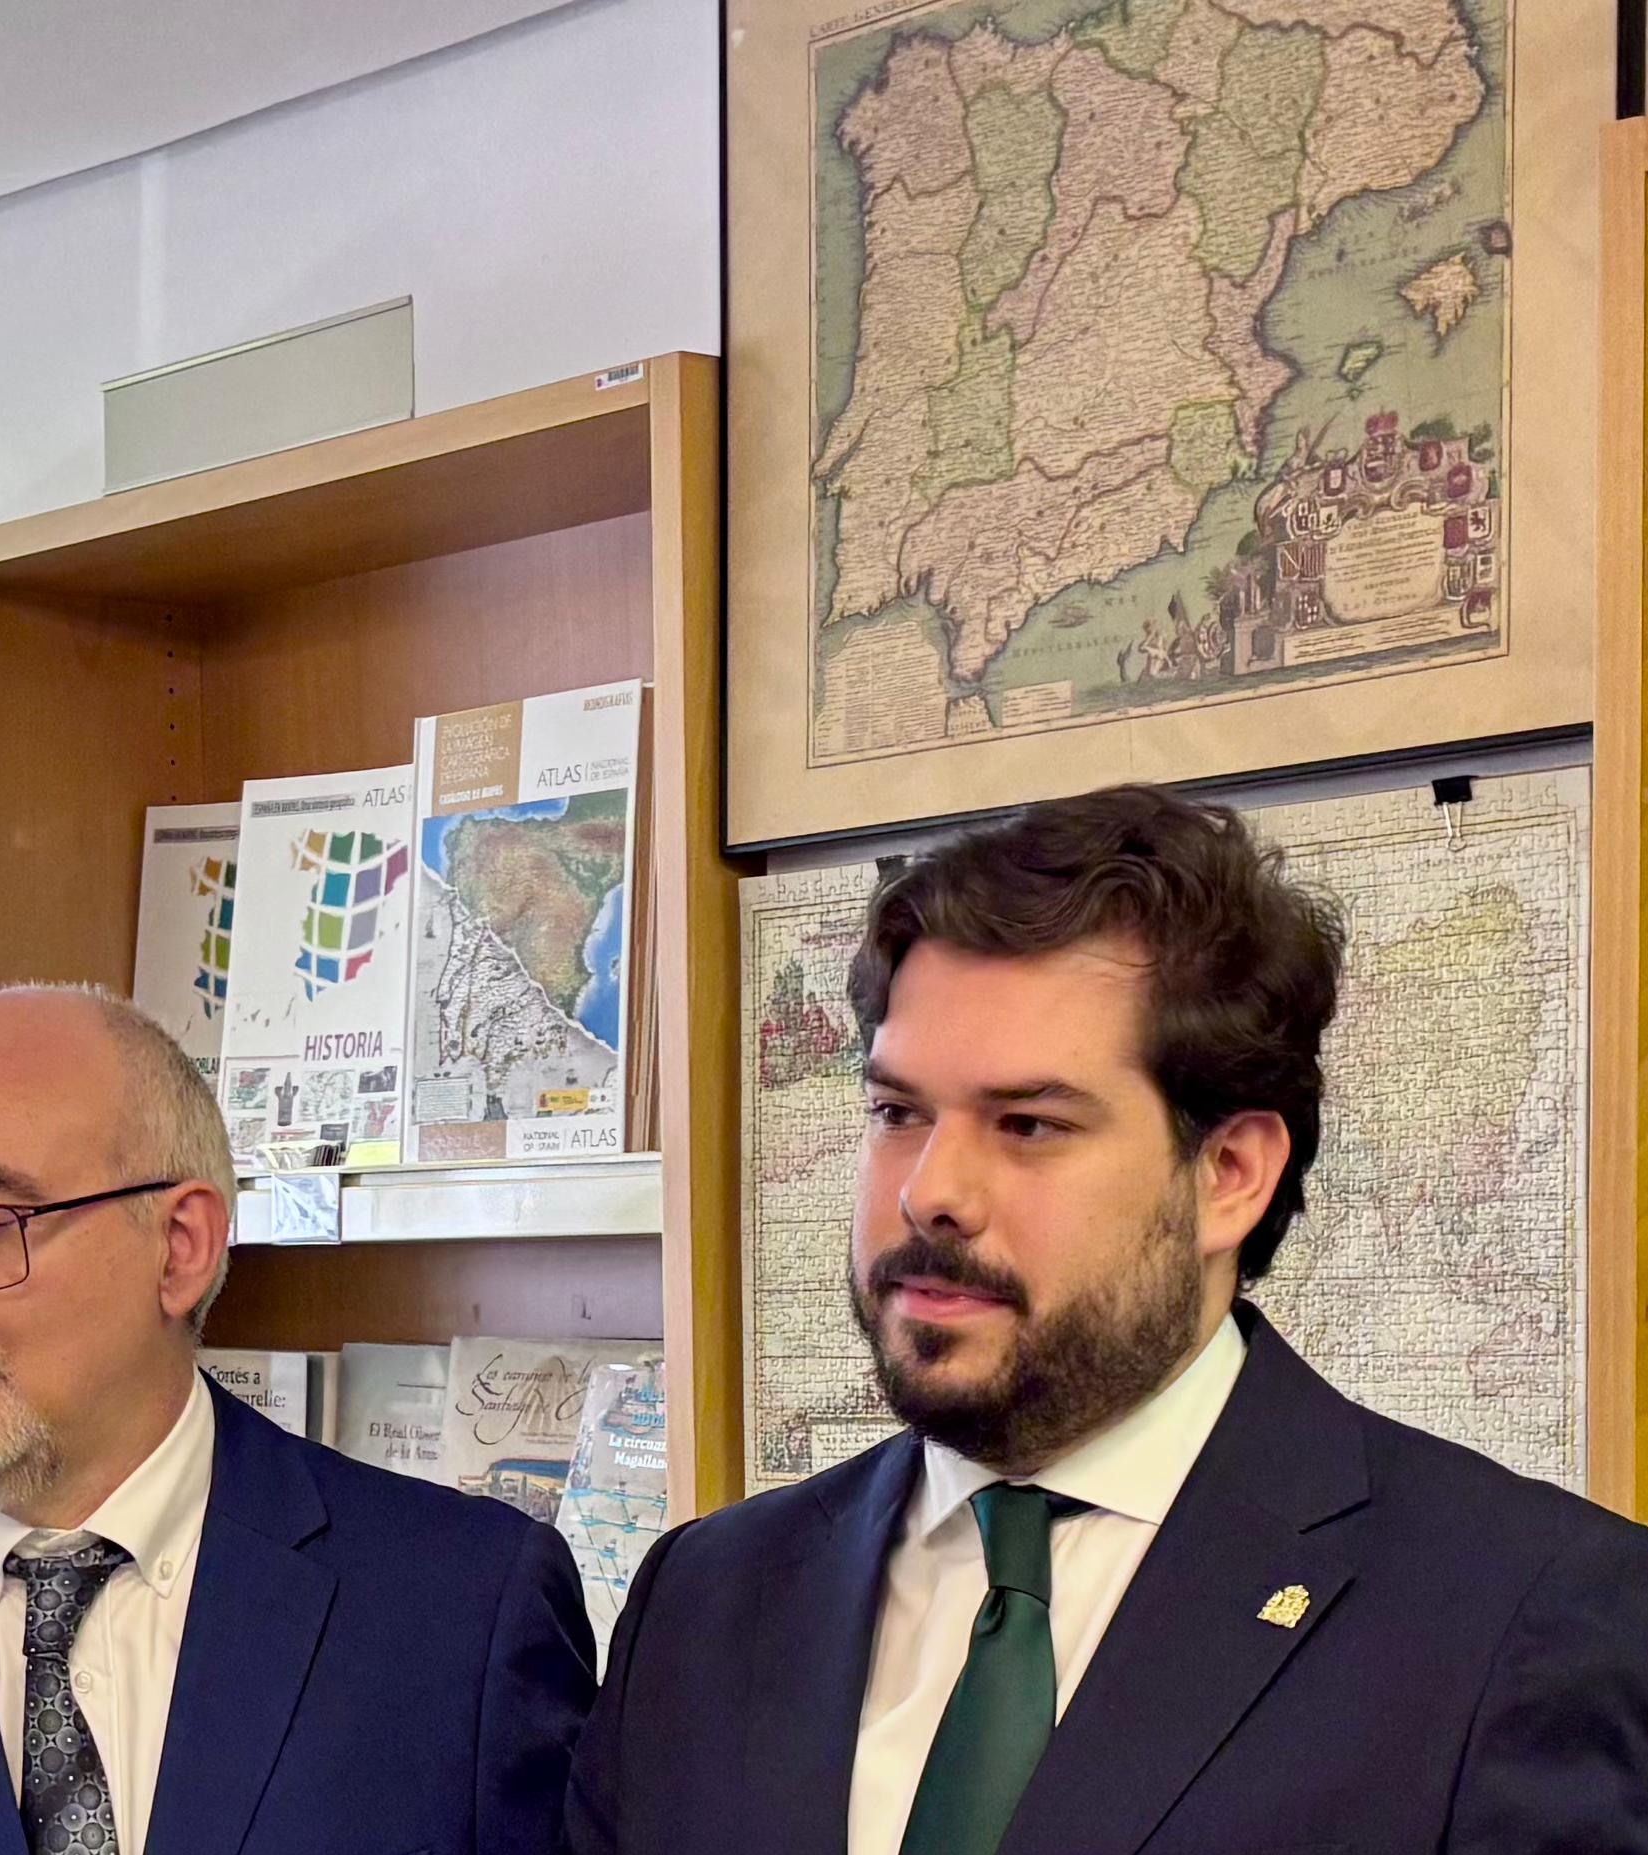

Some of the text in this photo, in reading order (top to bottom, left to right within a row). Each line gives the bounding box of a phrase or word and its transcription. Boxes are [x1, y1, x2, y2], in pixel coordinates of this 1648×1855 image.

[536, 763, 583, 788] ATLAS
[362, 787, 405, 808] ATLAS
[303, 1030, 384, 1061] HISTORIA
[570, 1127, 618, 1149] ATLAS
[253, 1371, 261, 1385] a
